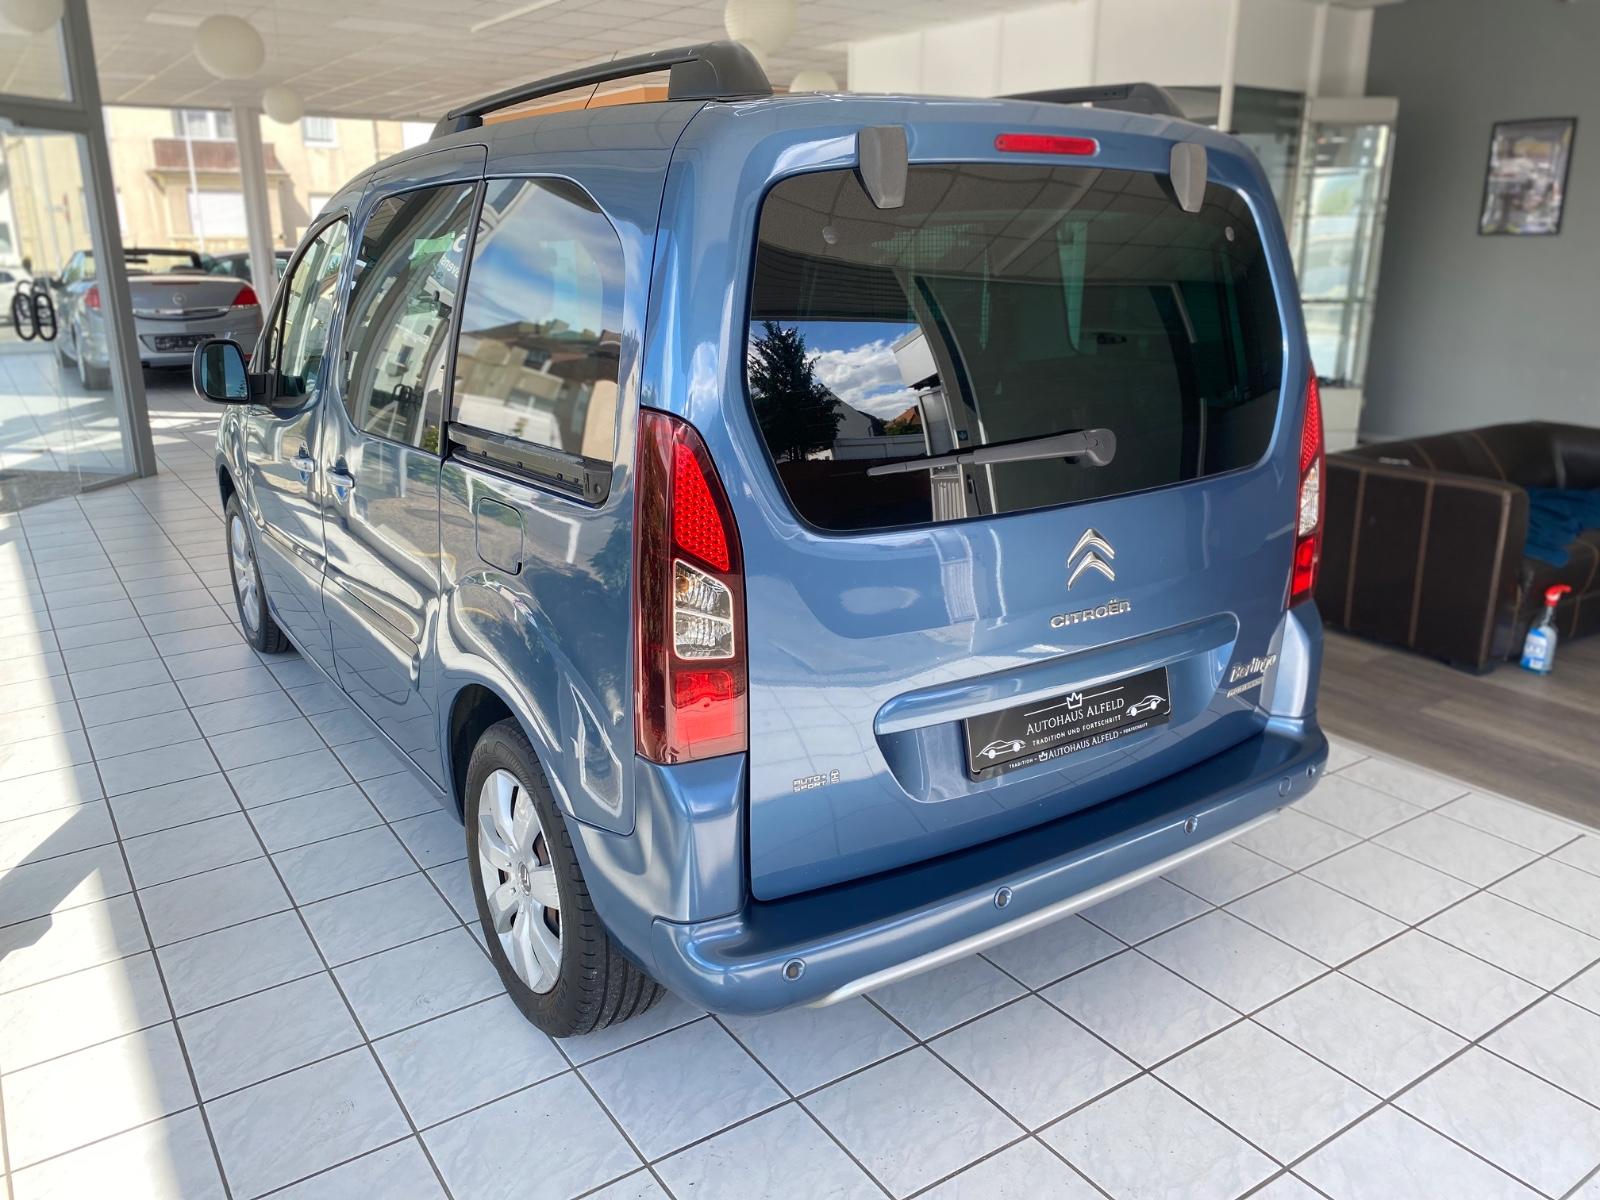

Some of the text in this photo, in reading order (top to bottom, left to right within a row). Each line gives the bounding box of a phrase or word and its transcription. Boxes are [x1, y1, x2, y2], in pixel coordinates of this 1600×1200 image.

[1050, 598, 1131, 628] CITROËN
[1026, 698, 1125, 736] AUTOHAUS ALFELD
[1032, 714, 1122, 747] TRADITION UND FORTSCHRITT
[1009, 758, 1034, 768] TRADITION
[1048, 740, 1090, 759] AUTOHAUS
[1092, 731, 1119, 746] ALFELD
